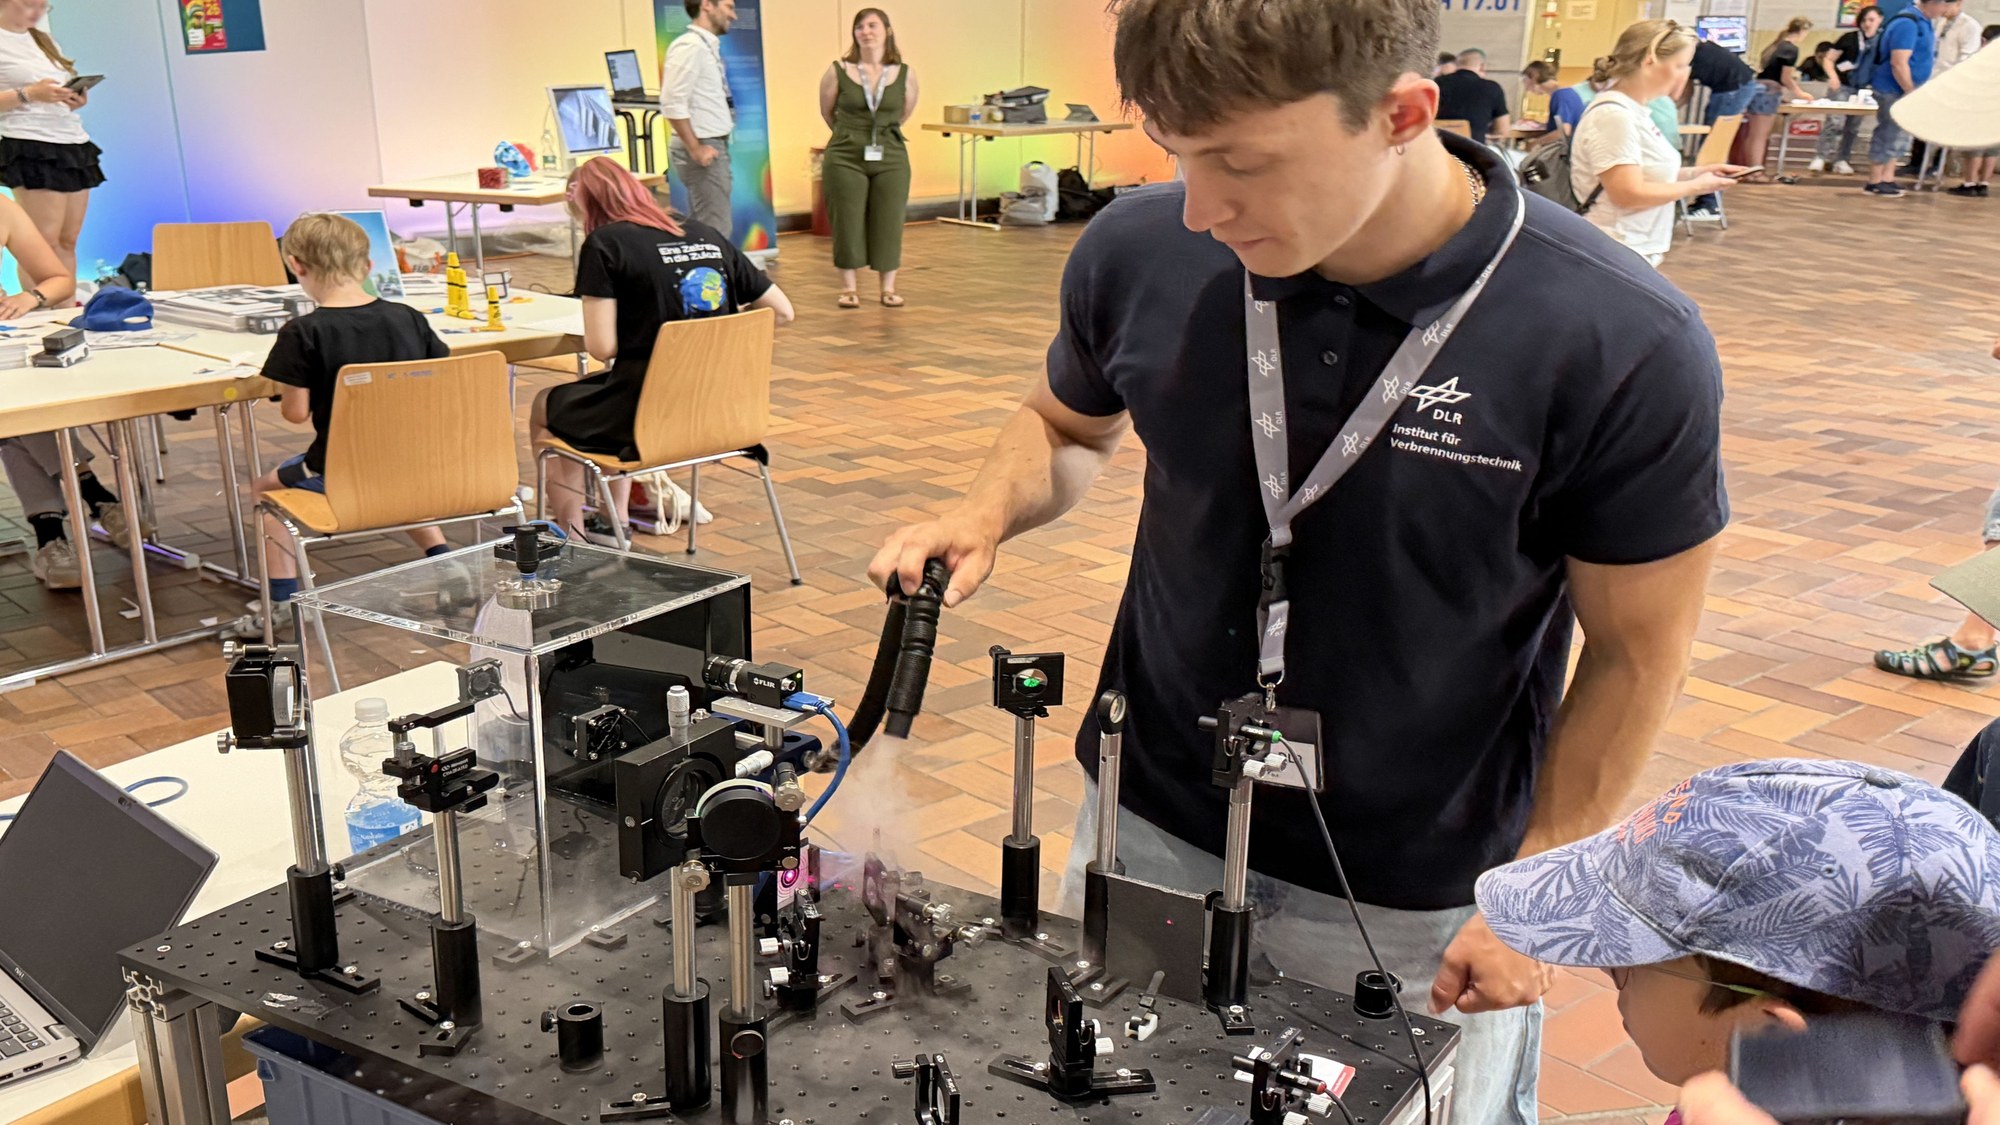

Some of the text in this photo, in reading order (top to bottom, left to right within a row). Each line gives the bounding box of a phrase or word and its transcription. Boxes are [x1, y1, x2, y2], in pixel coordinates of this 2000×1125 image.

[1440, 323, 1453, 339] DLR
[1400, 381, 1412, 395] DLR
[1433, 408, 1463, 425] DLR
[1392, 423, 1462, 446] Institut für
[1390, 437, 1523, 472] Verbrennungstechnik
[759, 679, 776, 689] FLIR
